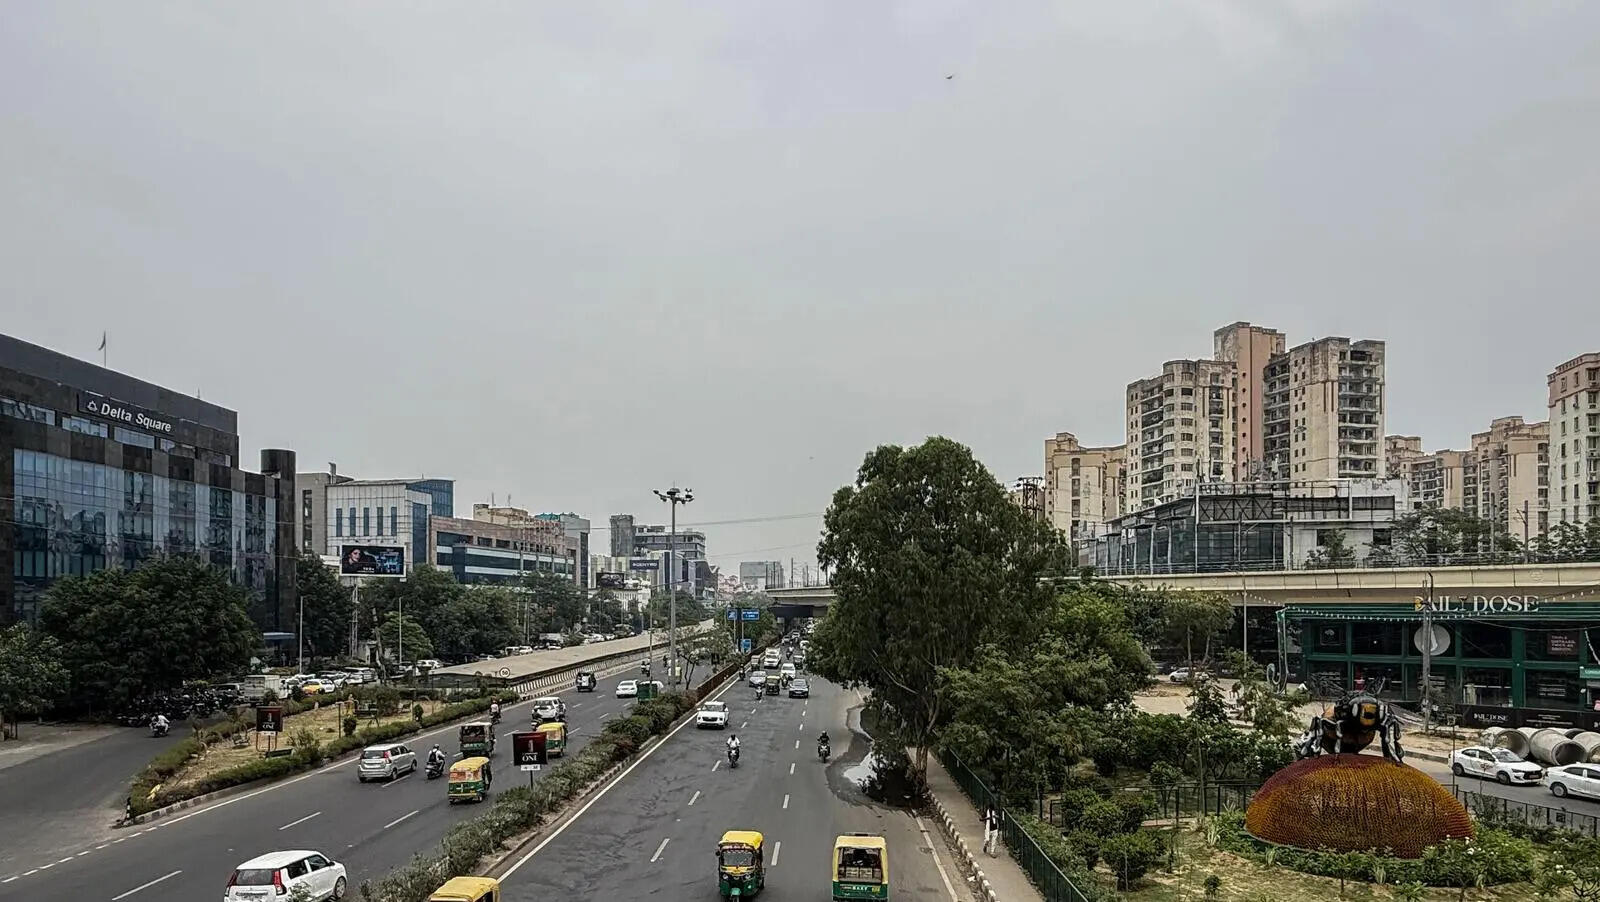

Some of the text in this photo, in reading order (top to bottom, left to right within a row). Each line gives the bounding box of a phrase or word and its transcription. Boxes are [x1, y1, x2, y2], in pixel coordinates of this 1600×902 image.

[101, 403, 172, 432] Delta Square
[1473, 595, 1539, 612] DOSE
